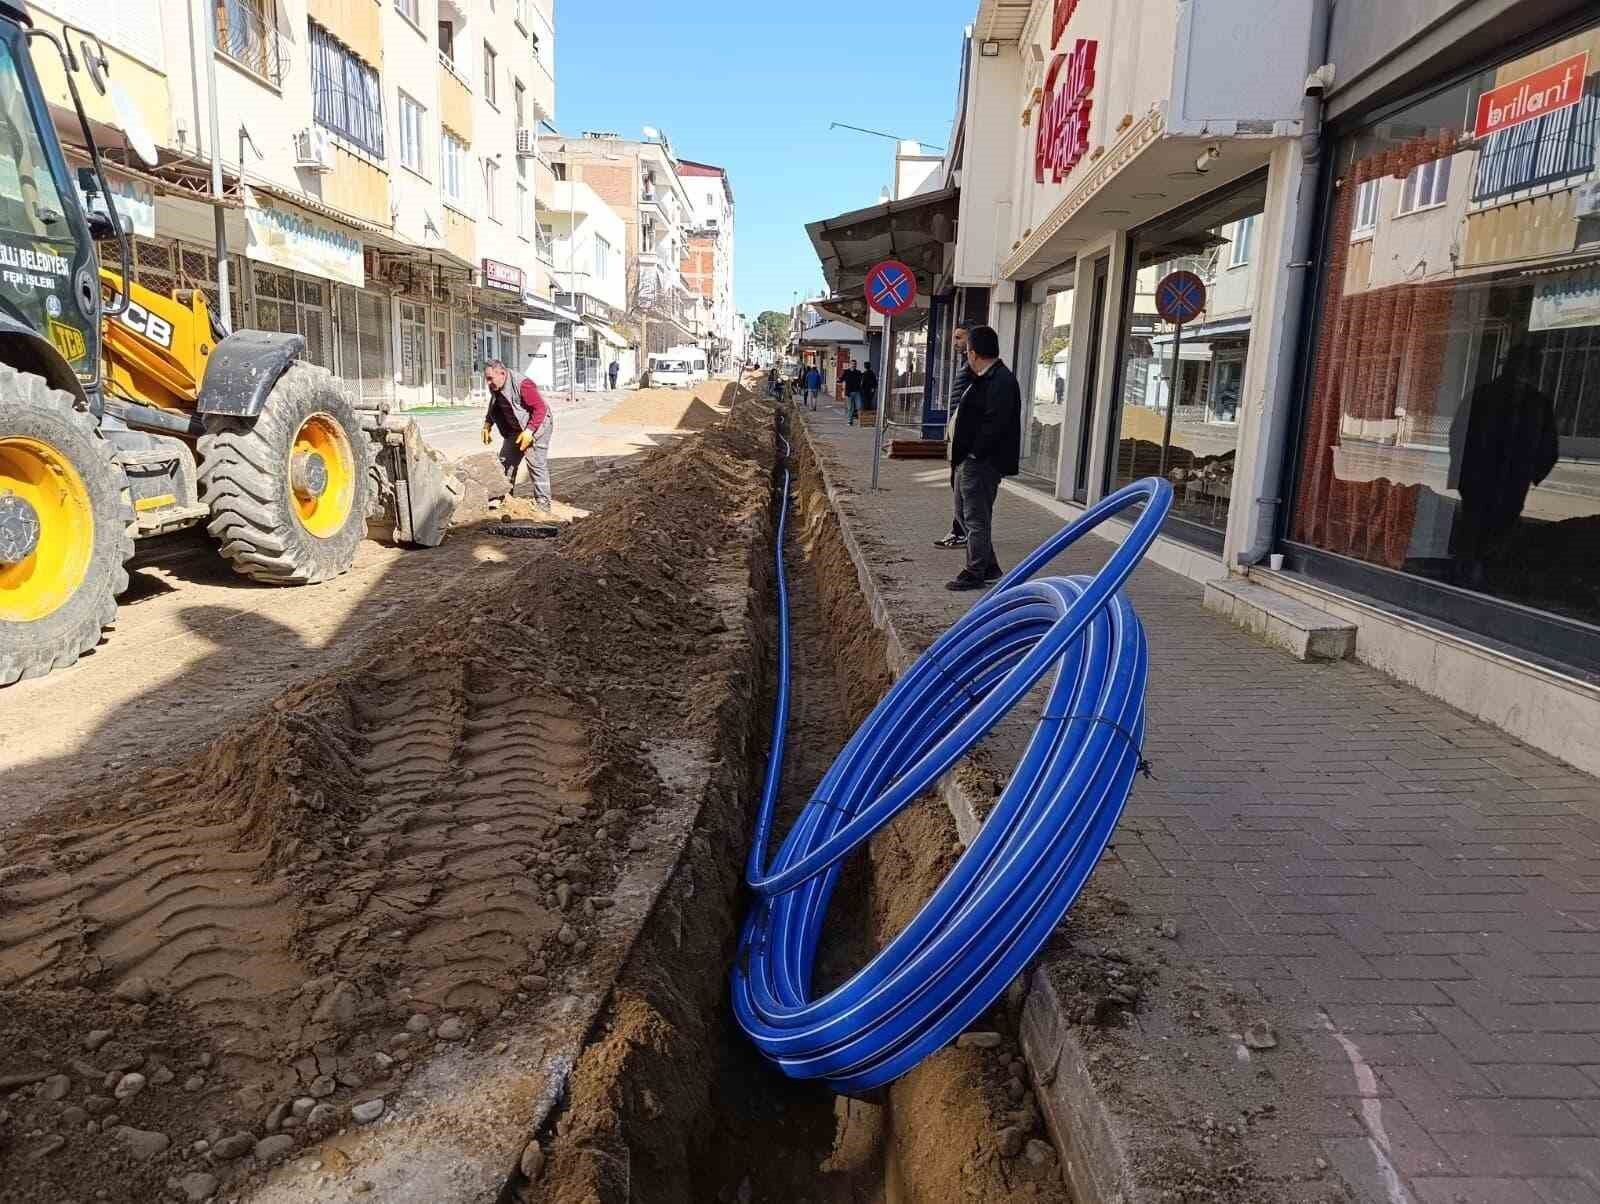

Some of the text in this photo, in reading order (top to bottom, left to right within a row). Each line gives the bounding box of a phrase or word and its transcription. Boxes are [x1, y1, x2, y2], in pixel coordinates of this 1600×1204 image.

[1487, 67, 1573, 128] brillant
[3, 270, 24, 284] FEN
[54, 325, 84, 357] JCB
[102, 293, 171, 347] JCB
